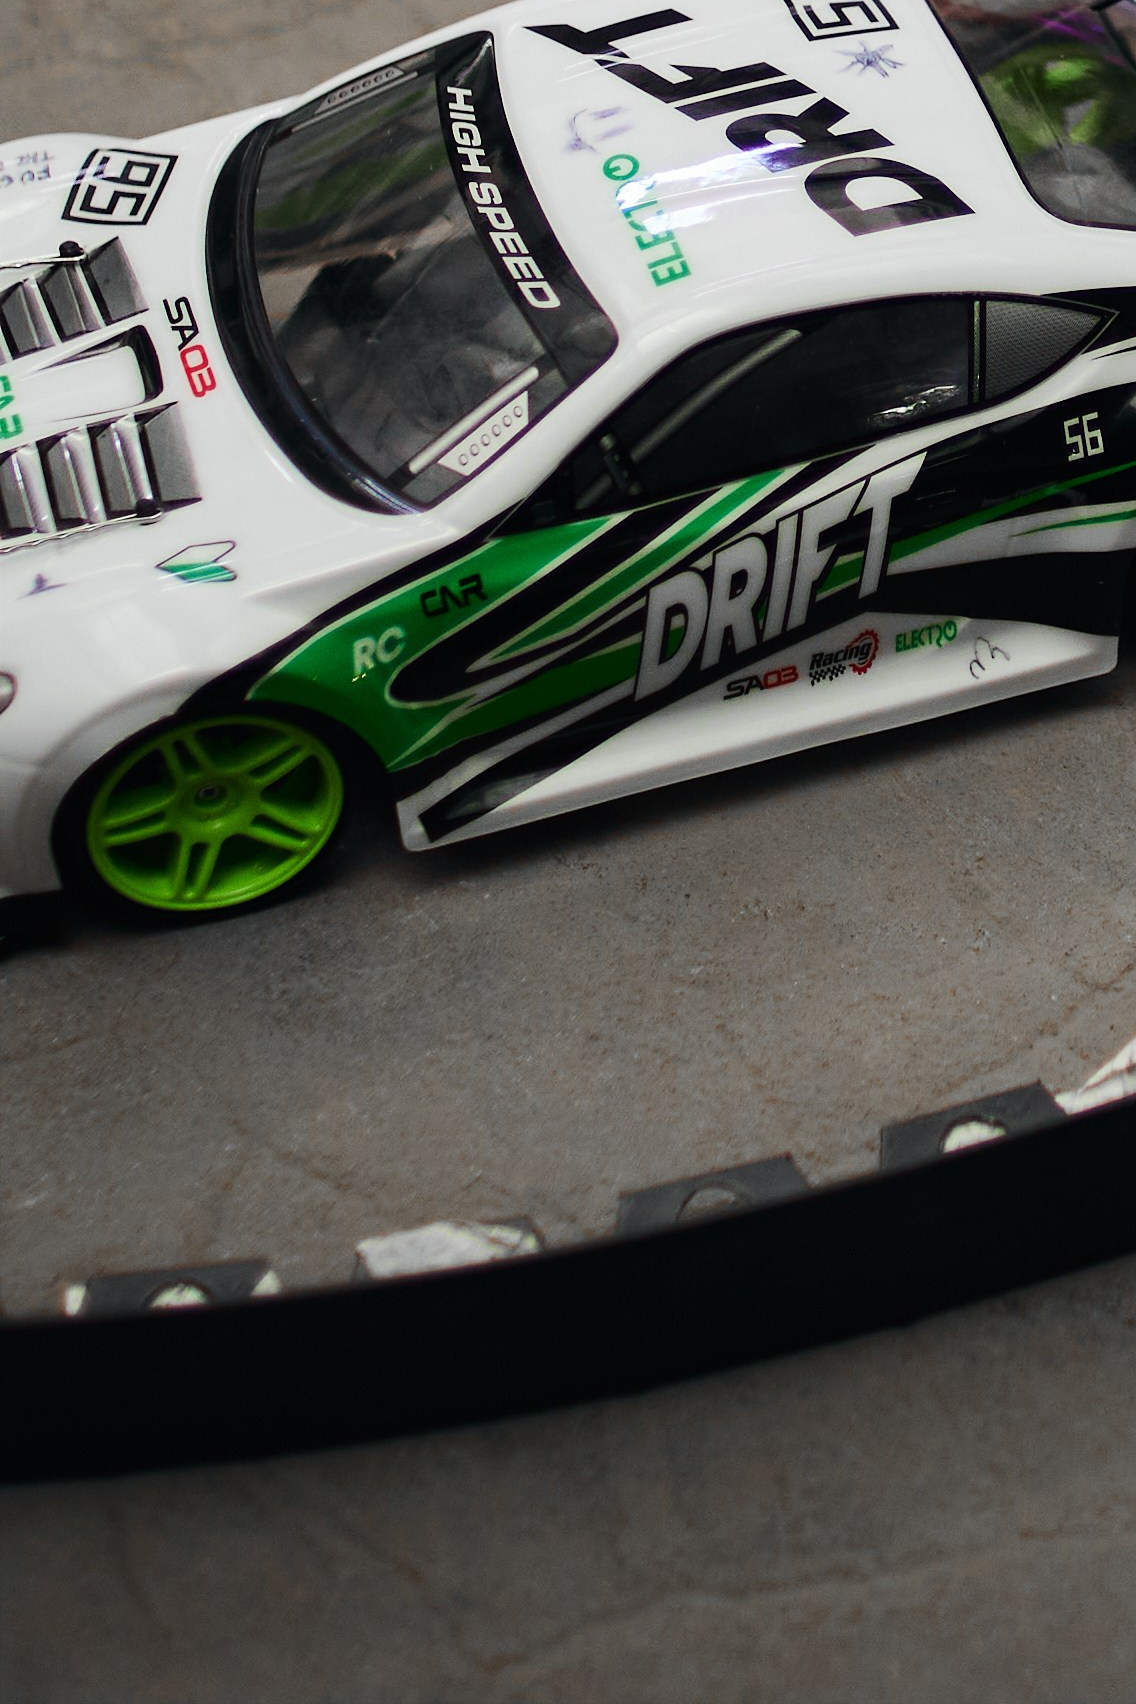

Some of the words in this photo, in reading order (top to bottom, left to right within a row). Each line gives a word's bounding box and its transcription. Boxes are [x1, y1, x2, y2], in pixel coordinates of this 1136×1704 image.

[446, 85, 492, 174] HIGH
[523, 8, 976, 237] DRIFT
[468, 180, 561, 310] SPEED
[602, 153, 692, 287] ELETO
[1065, 411, 1105, 461] 56
[420, 573, 488, 618] CAR
[635, 451, 928, 701] DRIFT
[353, 626, 406, 672] RC
[809, 640, 873, 671] Racing
[895, 619, 958, 654] ELECTRO
